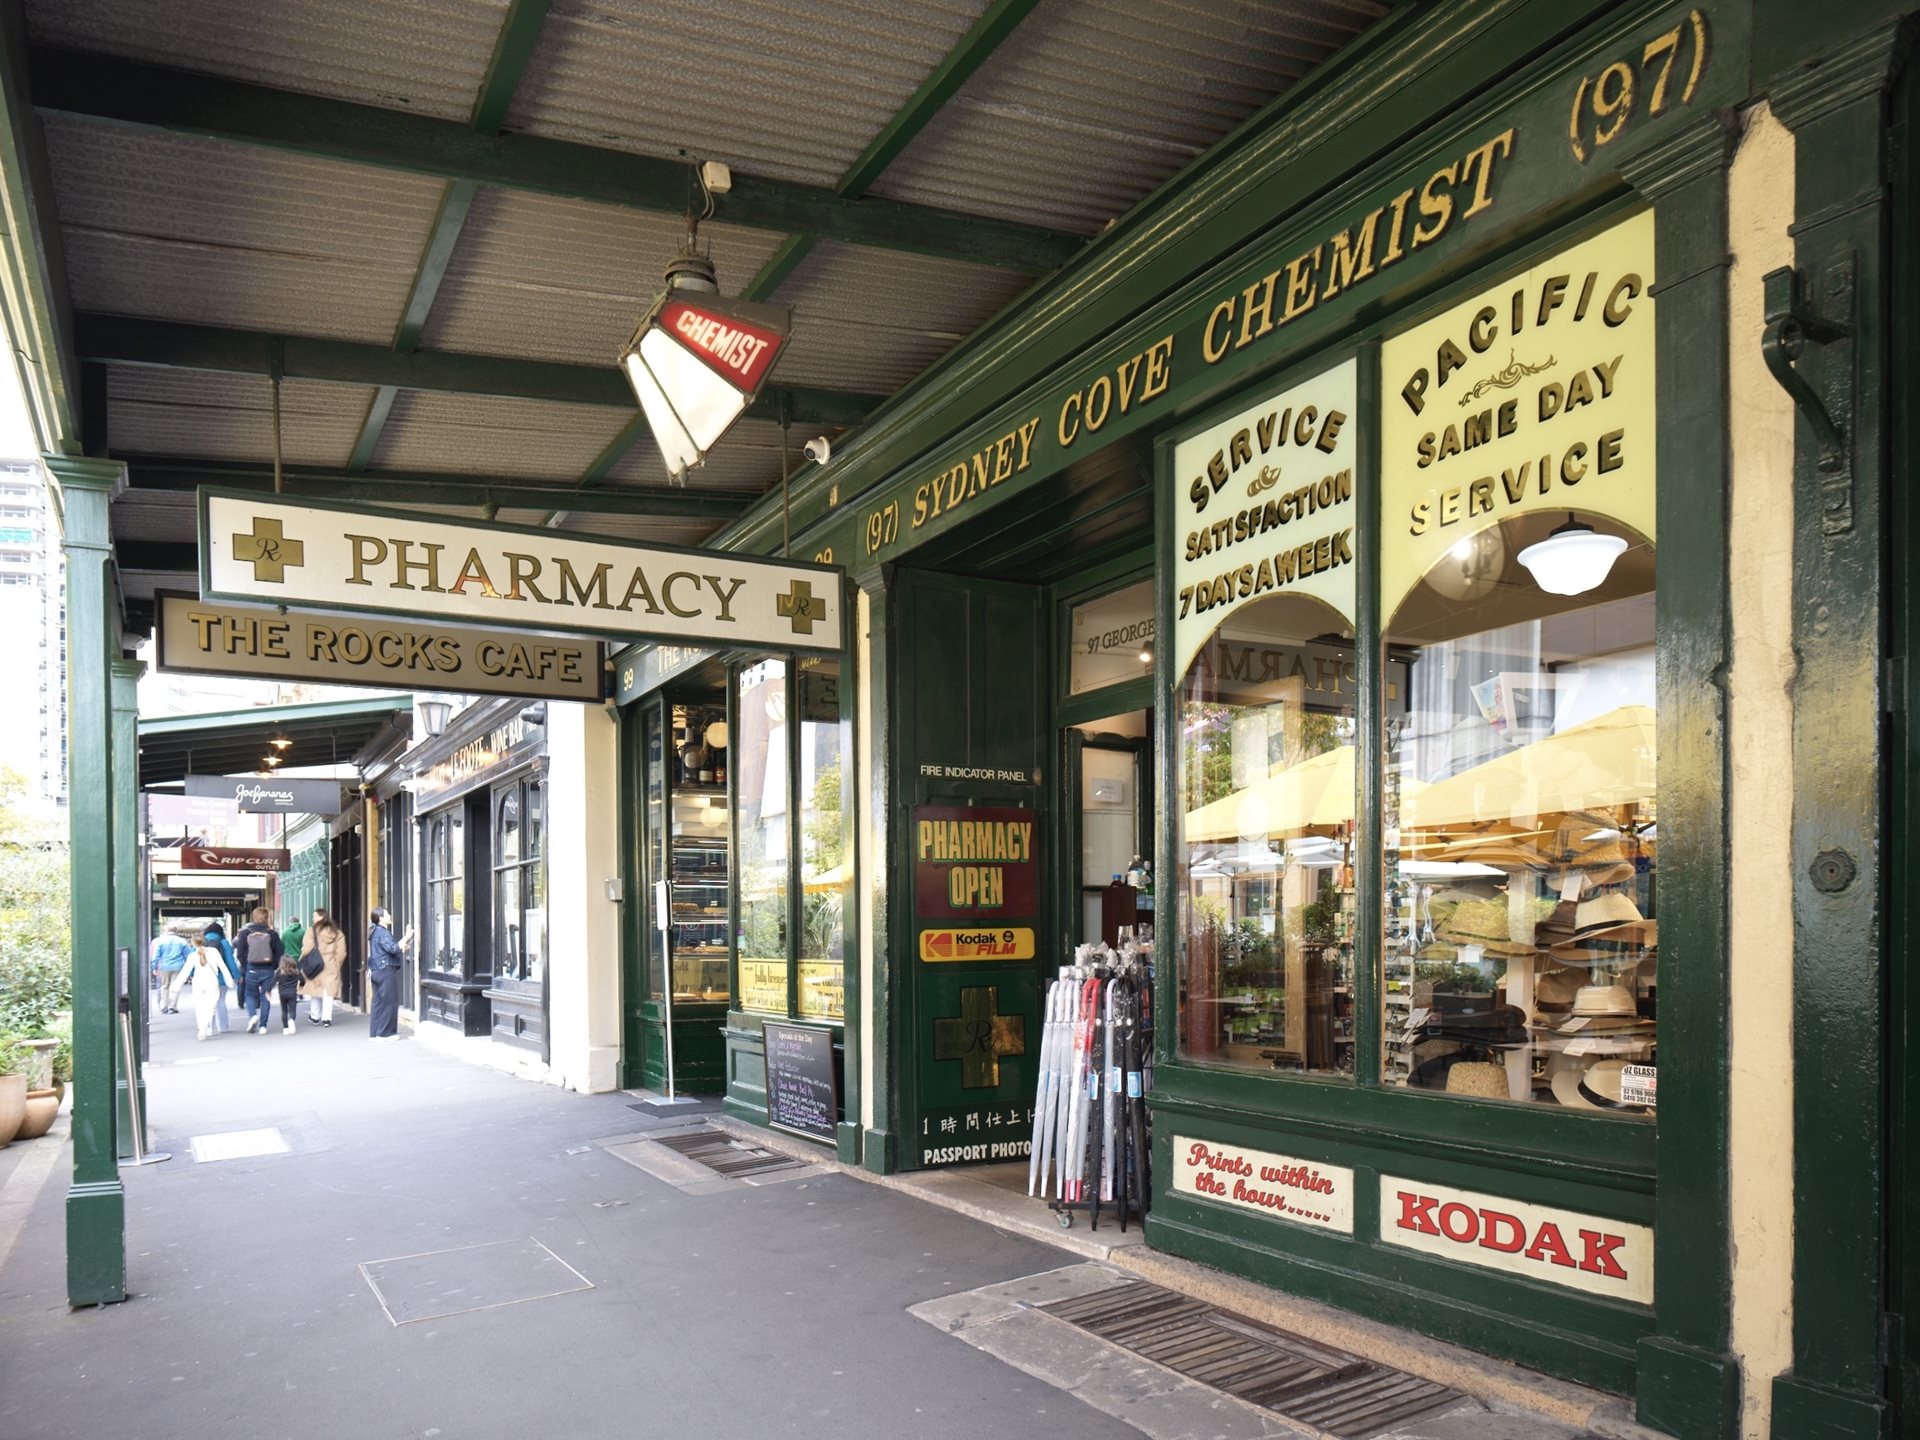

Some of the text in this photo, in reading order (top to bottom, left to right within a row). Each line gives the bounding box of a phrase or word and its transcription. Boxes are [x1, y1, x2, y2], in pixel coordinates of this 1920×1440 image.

[866, 8, 1708, 556] (97) SYDNEY COVE CHEMIST (97)
[676, 310, 768, 375] CHEMIST
[1401, 271, 1643, 416] PACIFIC
[1416, 354, 1625, 469] SAME DAY
[1189, 404, 1348, 514] SERVICE
[1246, 464, 1282, 498] &
[1409, 428, 1626, 537] SERVICE
[1185, 468, 1352, 562] SATISFACTION
[344, 533, 746, 622] PHARMACY
[187, 612, 583, 684] THE ROCKS CAFE
[1088, 618, 1155, 654] 97 GEORGE
[623, 667, 634, 692] 99
[656, 646, 681, 677] THE
[490, 724, 508, 754] WINE
[509, 718, 523, 747] BAR
[920, 765, 1028, 782] FIRE INDICATOR PANEL
[221, 857, 280, 865] RIP CURL
[918, 820, 1032, 862] PHARMACY
[950, 866, 1004, 907] OPEN
[956, 933, 997, 944] Kodak
[976, 943, 1017, 955] FILM
[1634, 1067, 1656, 1077] GLASS
[924, 1144, 988, 1165] PASSPORT
[1187, 1143, 1335, 1195] Prints within
[1195, 1172, 1226, 1196] the
[1396, 1190, 1629, 1281] KODAK
